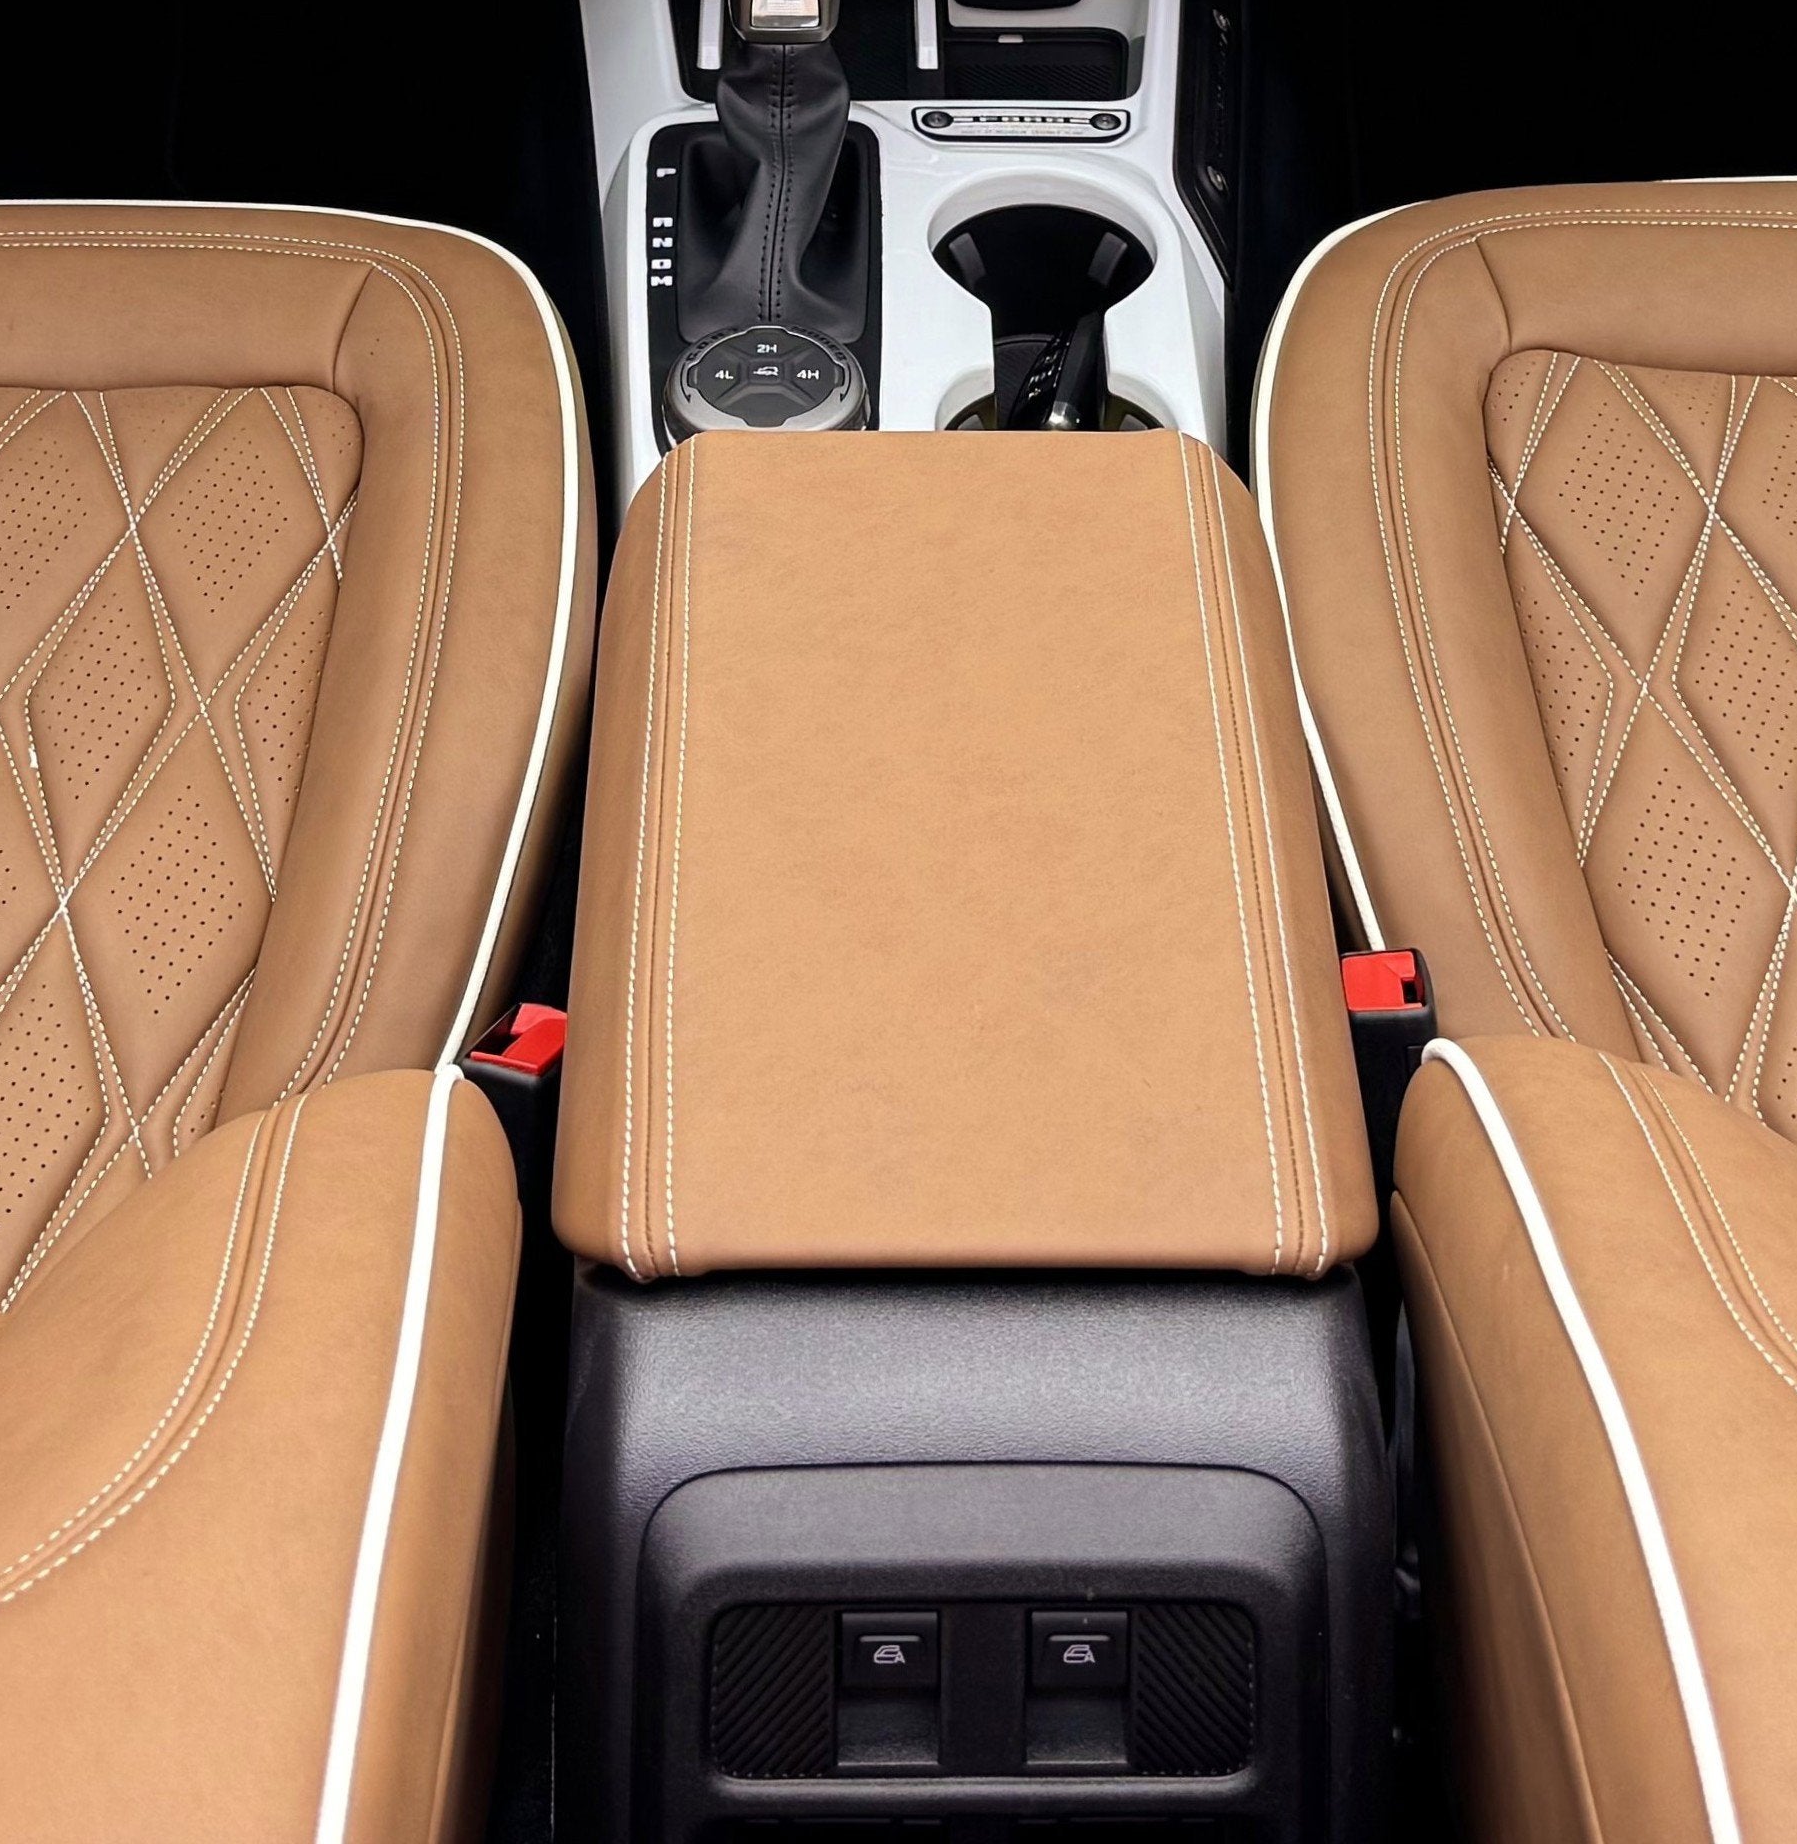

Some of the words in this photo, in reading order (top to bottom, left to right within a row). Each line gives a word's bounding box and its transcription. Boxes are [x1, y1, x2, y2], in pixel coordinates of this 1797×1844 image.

[650, 275, 673, 287] M
[756, 343, 777, 354] 2H
[714, 369, 734, 380] 4L
[796, 369, 819, 380] 4H
